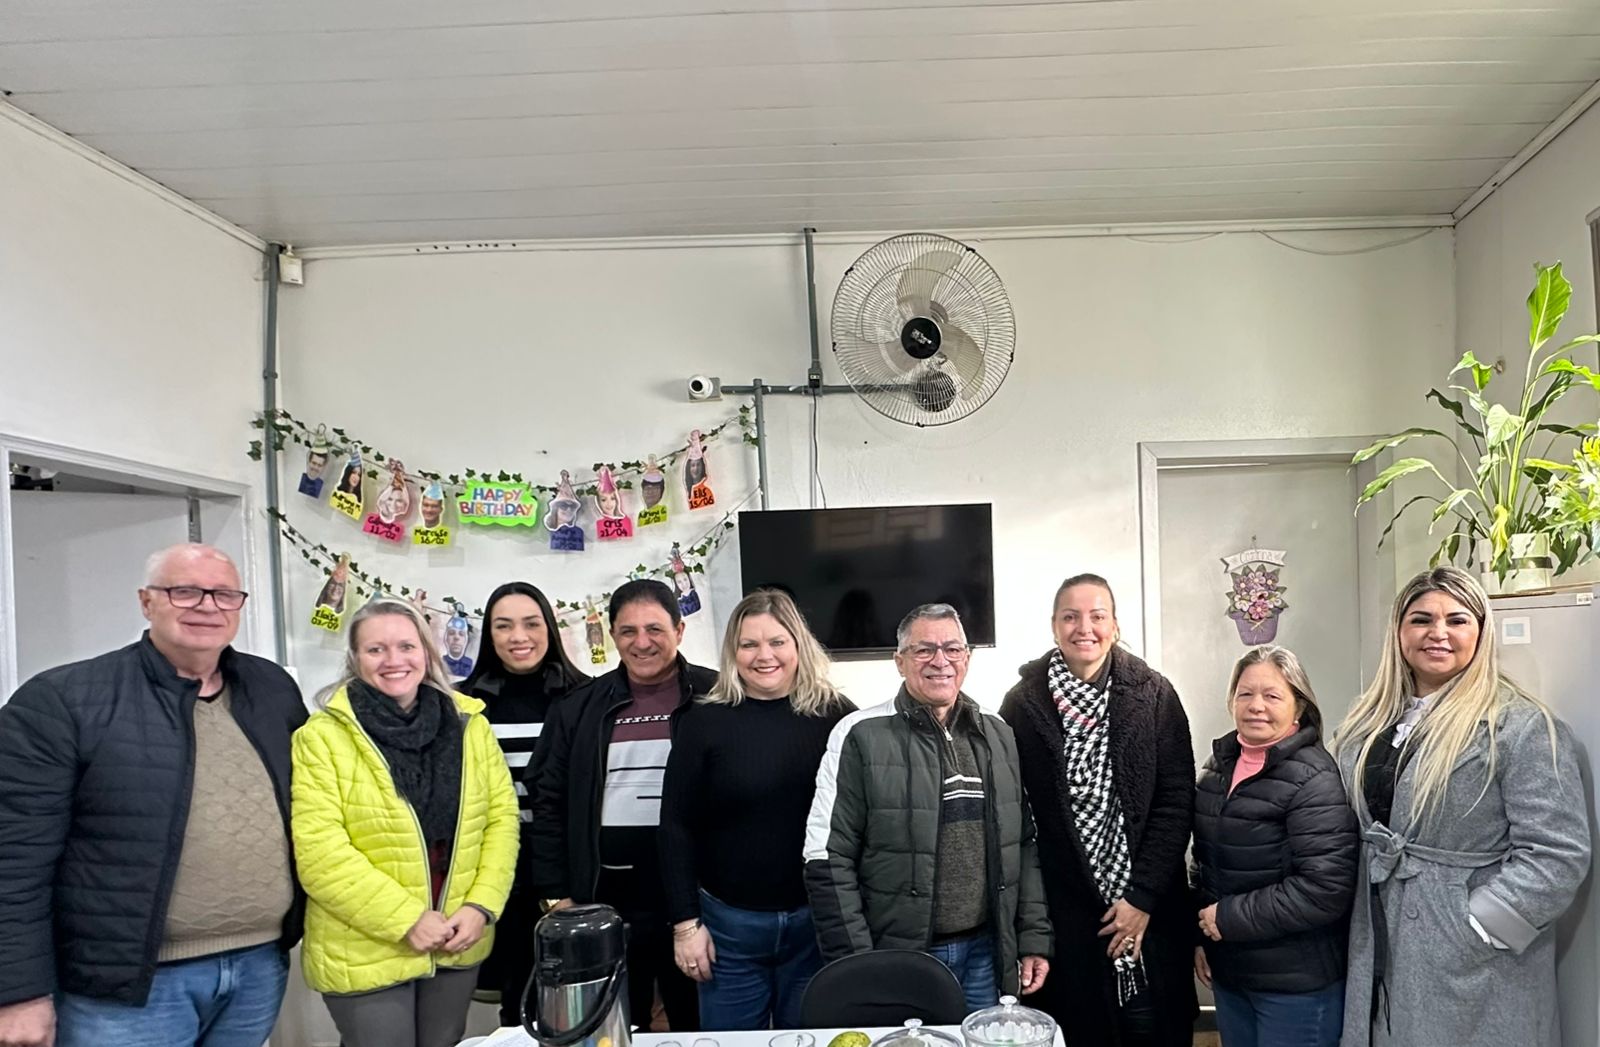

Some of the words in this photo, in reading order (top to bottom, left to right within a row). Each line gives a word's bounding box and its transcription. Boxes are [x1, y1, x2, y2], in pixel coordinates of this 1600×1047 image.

[473, 487, 522, 503] HAPPY
[689, 496, 715, 509] 15/06
[459, 501, 533, 516] BIRTHDAY
[370, 525, 397, 540] 11/02
